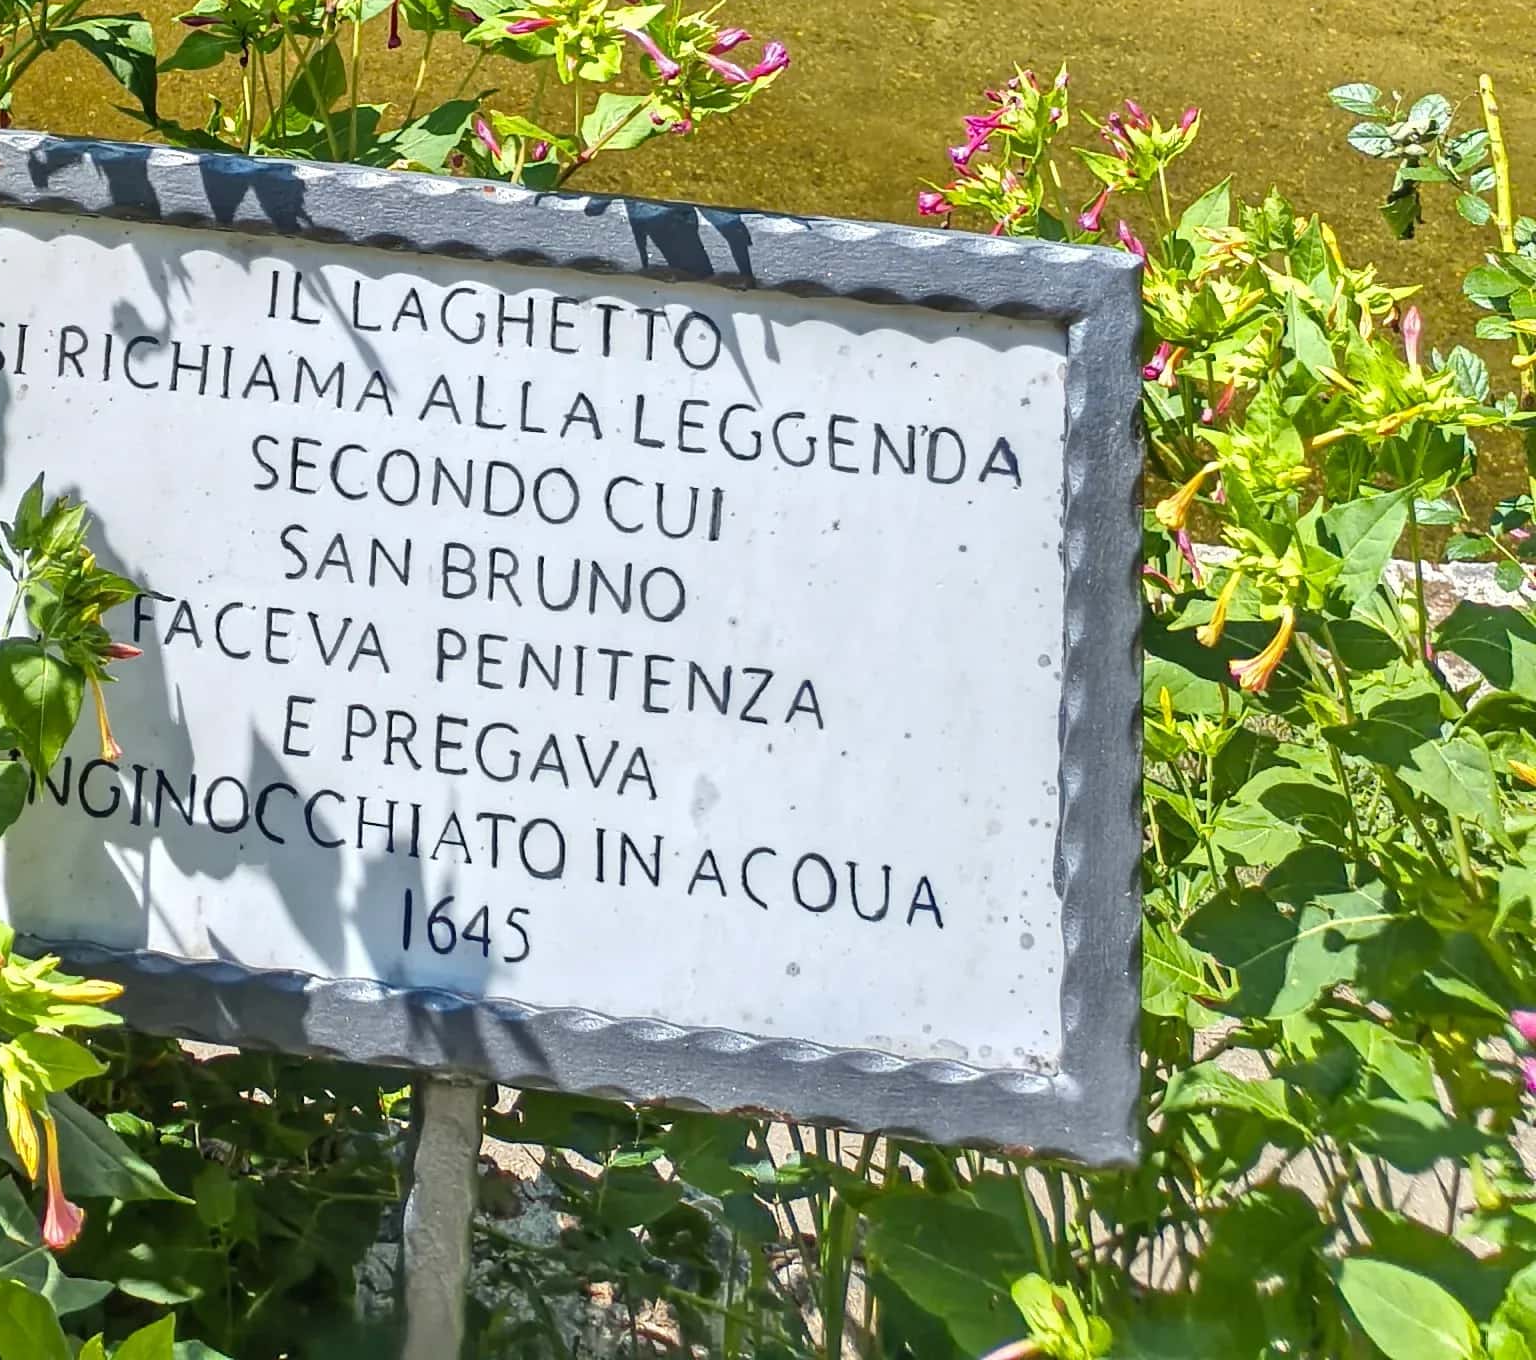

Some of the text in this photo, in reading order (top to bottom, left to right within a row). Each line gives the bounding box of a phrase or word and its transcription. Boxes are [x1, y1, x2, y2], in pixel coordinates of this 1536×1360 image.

[267, 270, 721, 370] IL LAGHETTO
[58, 324, 393, 416] RICHIAMA
[418, 374, 602, 440] ALLA
[633, 393, 1023, 488] LEGGENDA
[252, 434, 726, 542] SECONDO CUI
[280, 524, 686, 622] SAN BRUNO
[132, 592, 825, 730] FACEVA PENITENZA
[282, 695, 658, 800] E PREGAVA
[8, 748, 566, 880] NGINOCCHIATO
[595, 827, 664, 887] IN
[401, 887, 531, 963] 1645
